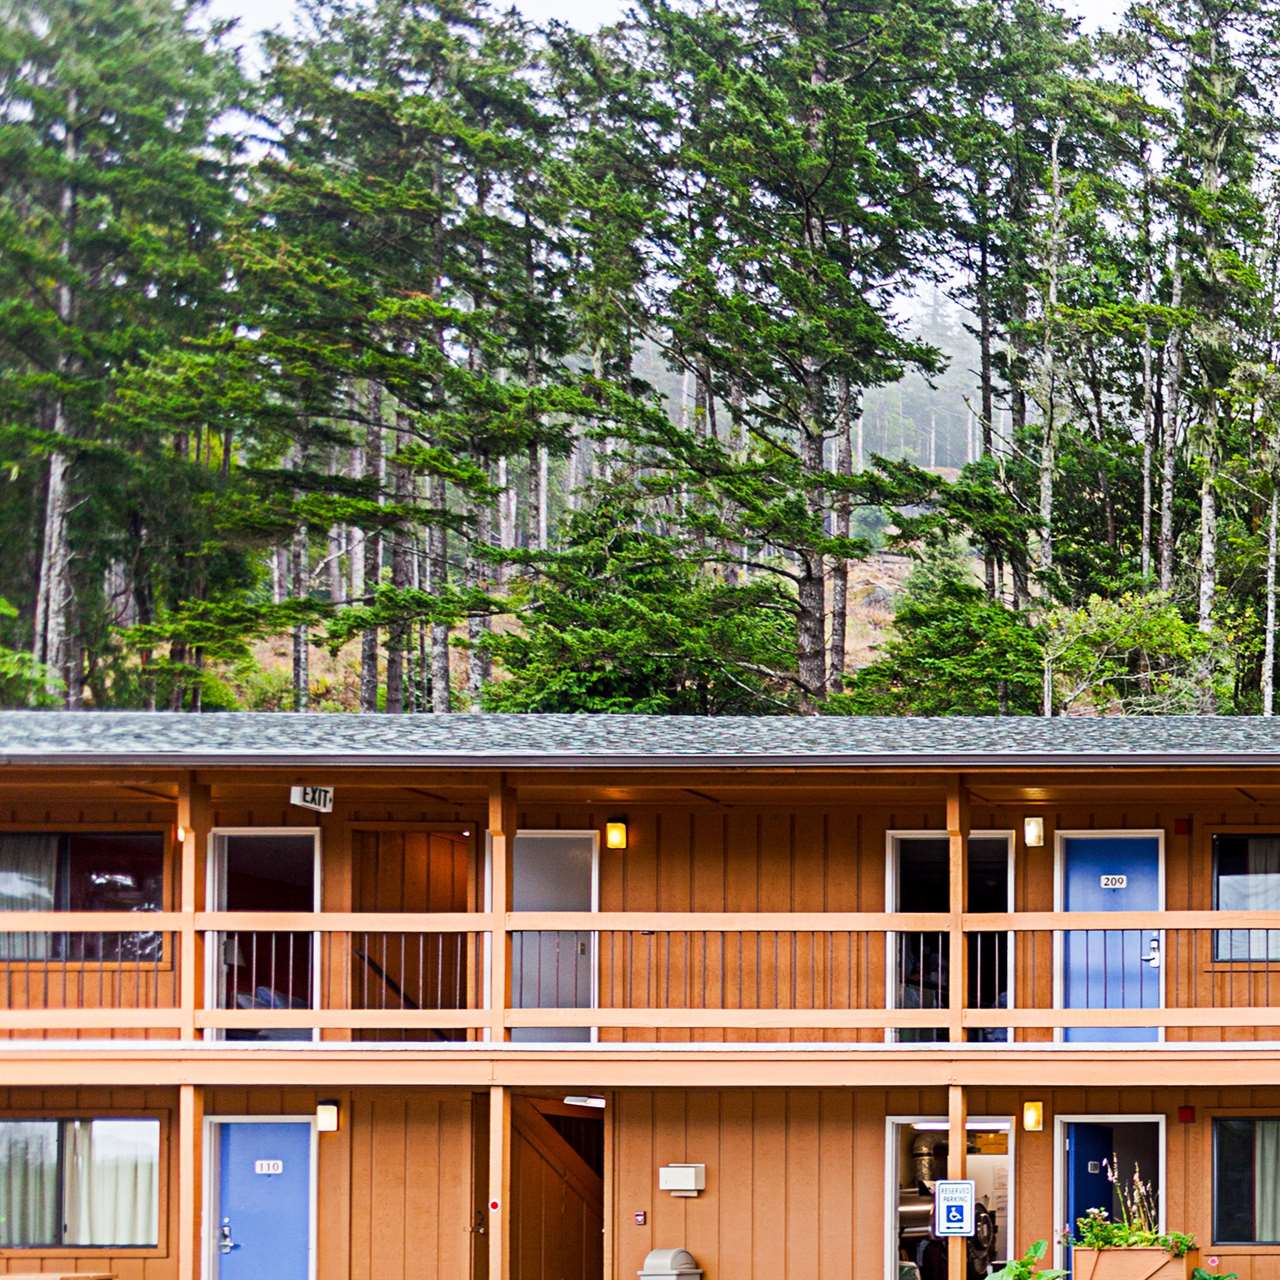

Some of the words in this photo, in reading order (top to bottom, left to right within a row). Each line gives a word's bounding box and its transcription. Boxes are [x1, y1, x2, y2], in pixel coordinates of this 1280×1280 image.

[303, 786, 330, 808] EXIT
[1103, 877, 1125, 888] 209
[259, 1162, 280, 1173] 110
